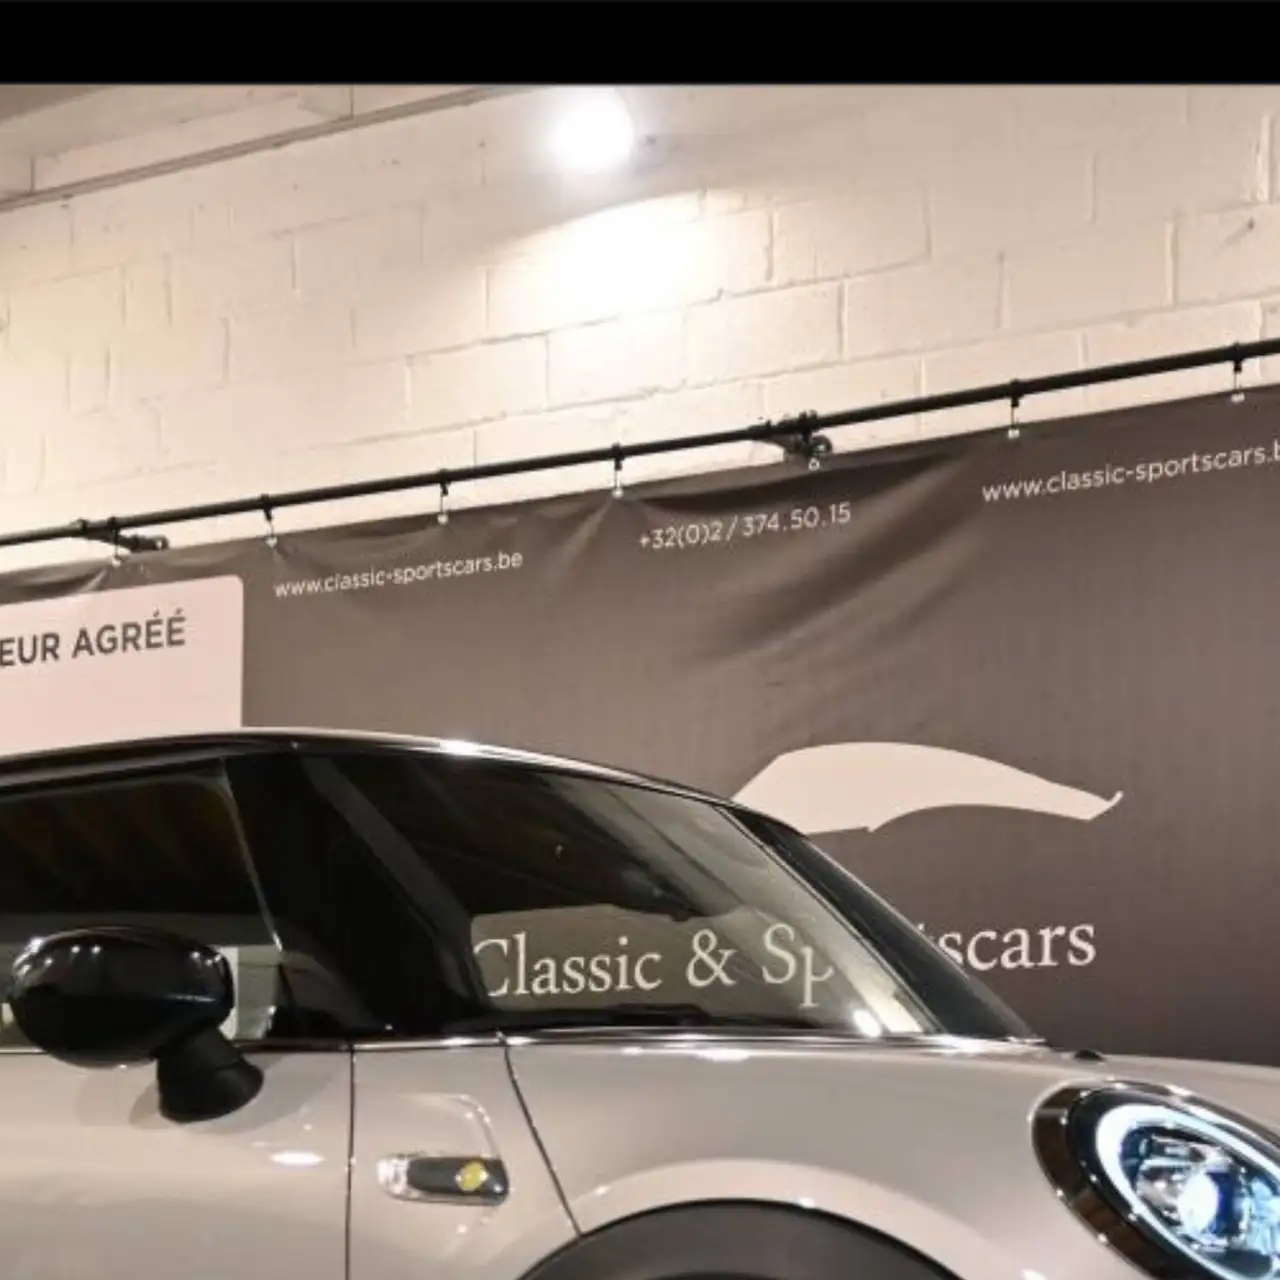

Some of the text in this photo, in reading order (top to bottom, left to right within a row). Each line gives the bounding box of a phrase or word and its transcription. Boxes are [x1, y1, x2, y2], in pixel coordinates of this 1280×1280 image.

[272, 550, 523, 598] www.classic-sportscars.be
[71, 607, 187, 659] AGRÉÉ
[685, 928, 738, 989] &
